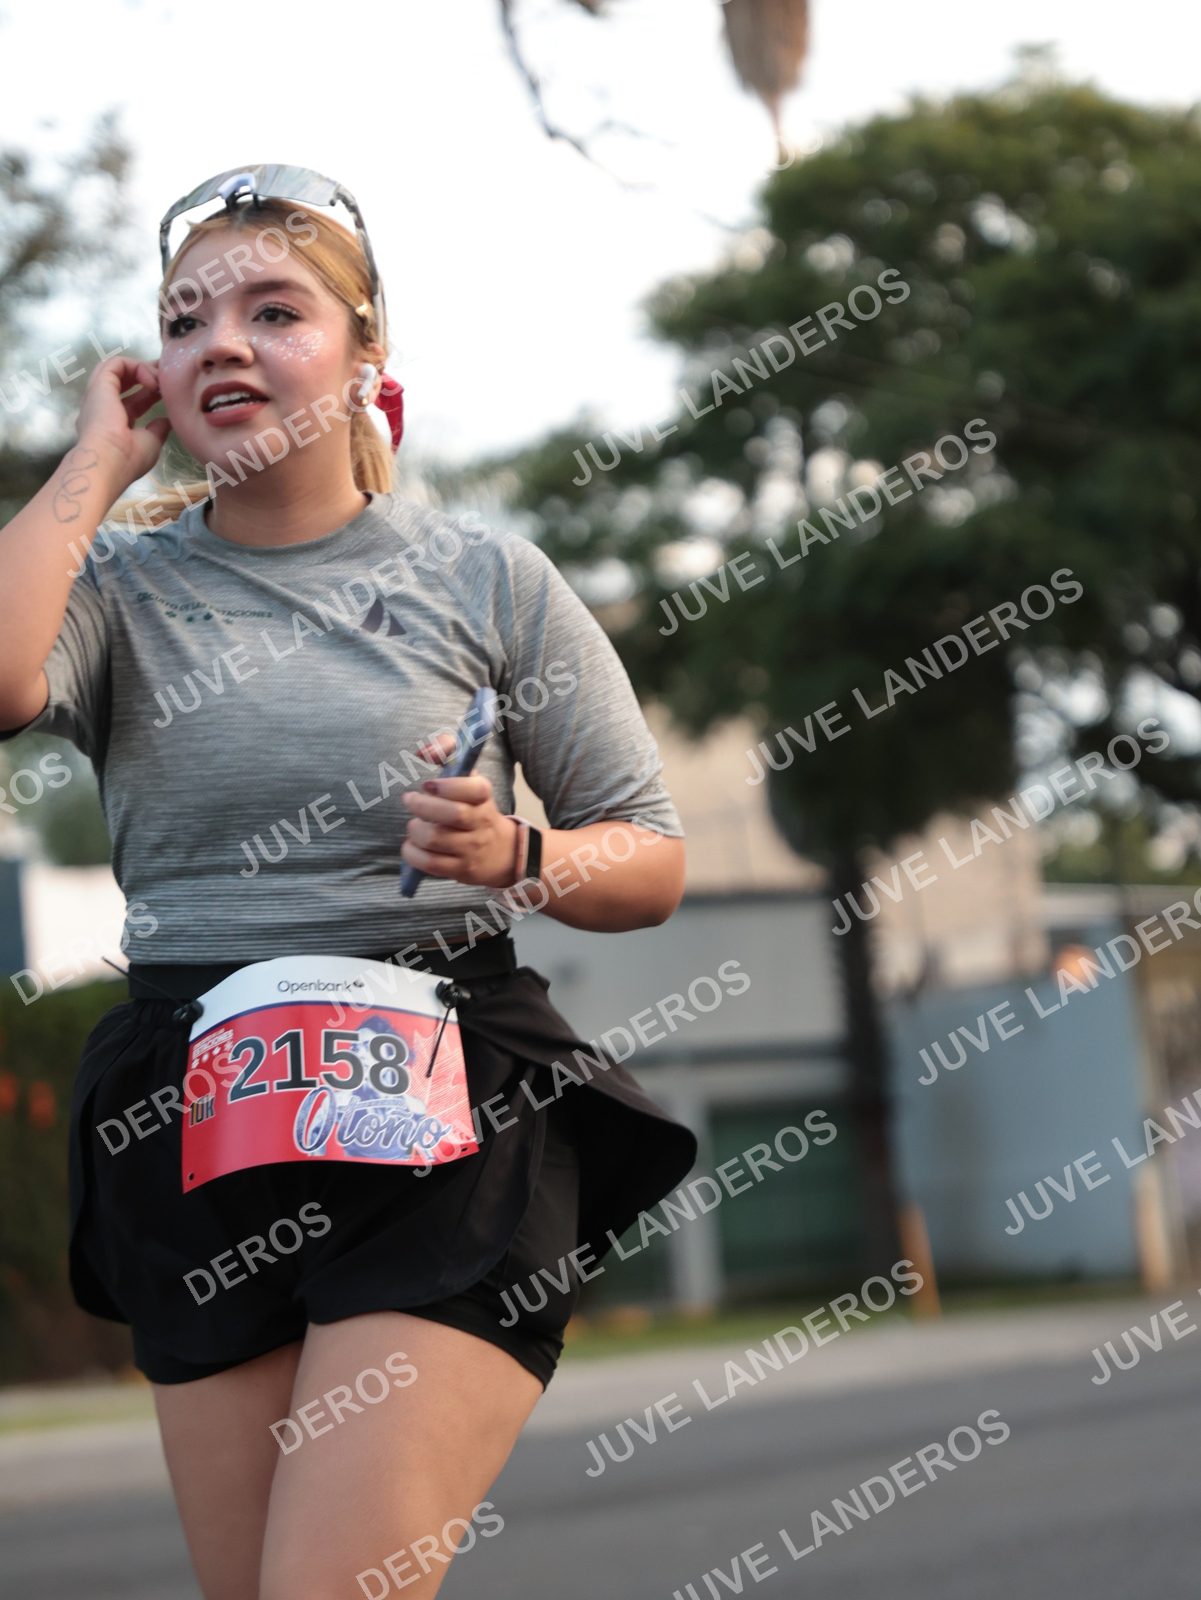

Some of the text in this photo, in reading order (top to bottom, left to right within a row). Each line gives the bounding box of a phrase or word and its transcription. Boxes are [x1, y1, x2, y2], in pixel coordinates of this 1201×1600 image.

[277, 979, 352, 995] Openbank
[228, 1028, 411, 1105] 2158
[189, 1094, 216, 1128] 10K
[293, 1086, 452, 1154] Otoño
